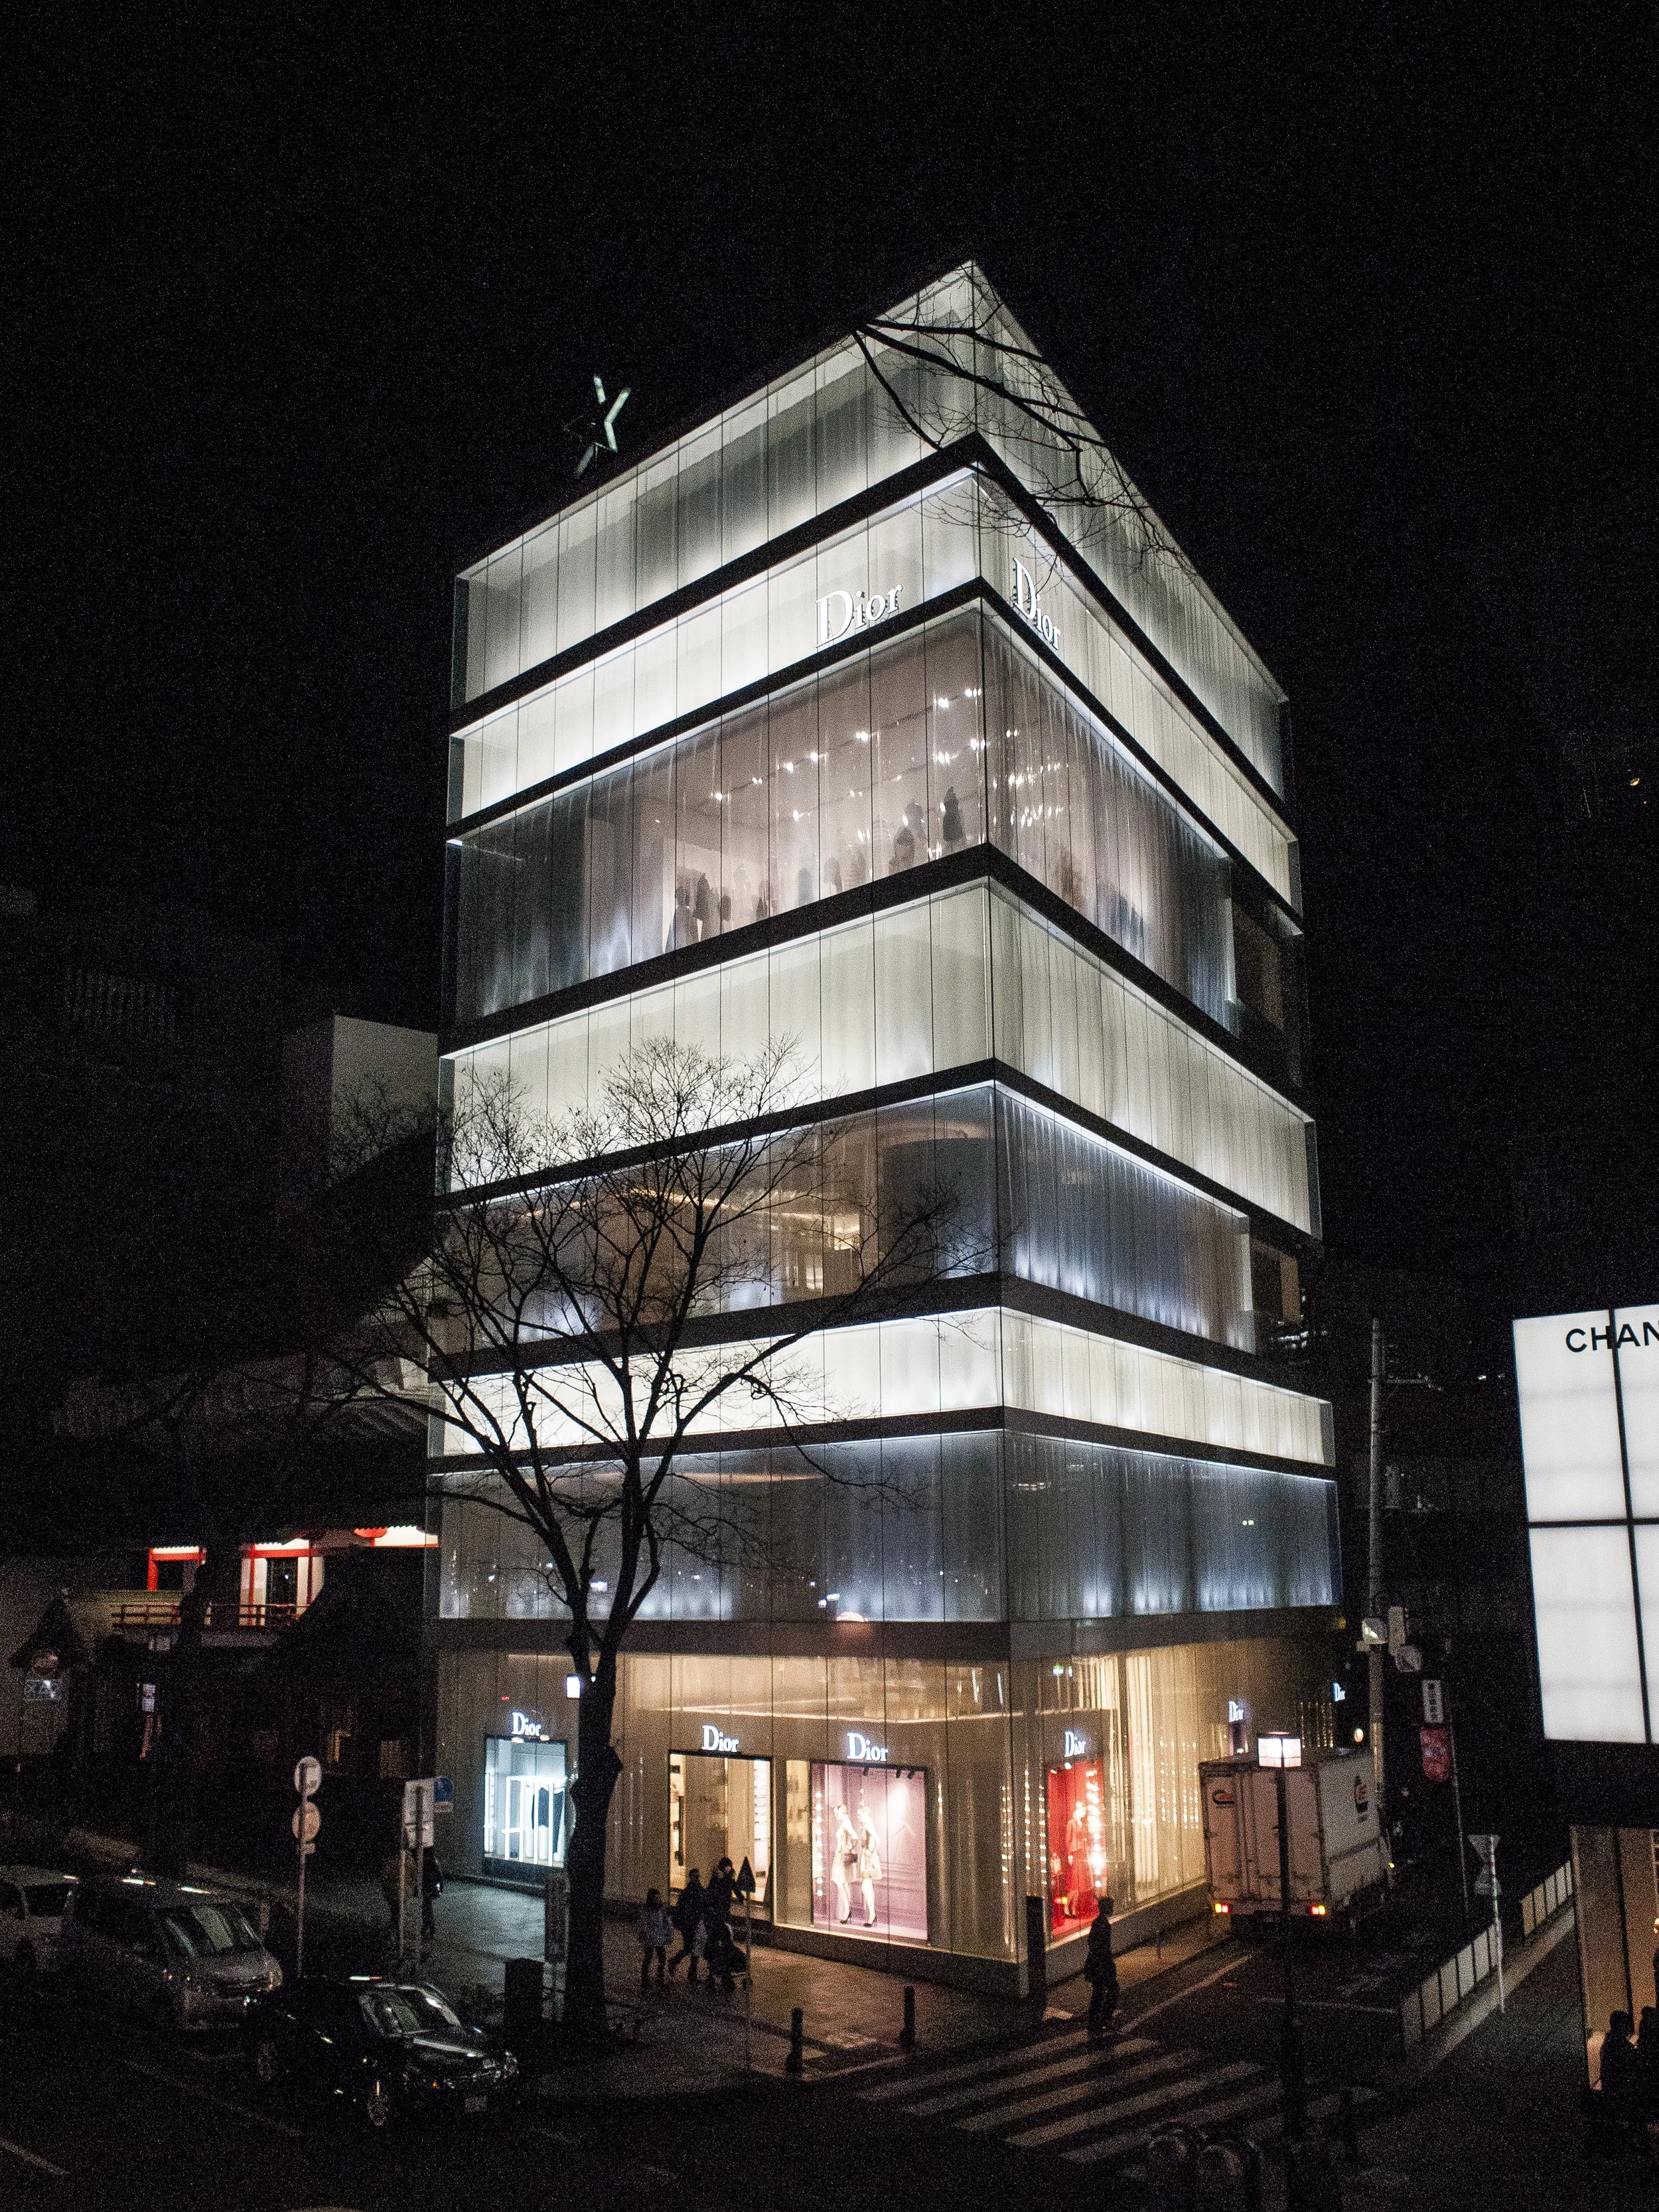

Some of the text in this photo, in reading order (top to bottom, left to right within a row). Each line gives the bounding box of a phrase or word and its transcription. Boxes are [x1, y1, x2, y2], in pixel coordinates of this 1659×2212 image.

[814, 584, 903, 648] Dior
[1013, 557, 1060, 650] Dior
[511, 1712, 541, 1736] Dior
[701, 1725, 739, 1752] Dior
[847, 1732, 889, 1761] Dior
[1064, 1731, 1086, 1757] Dior
